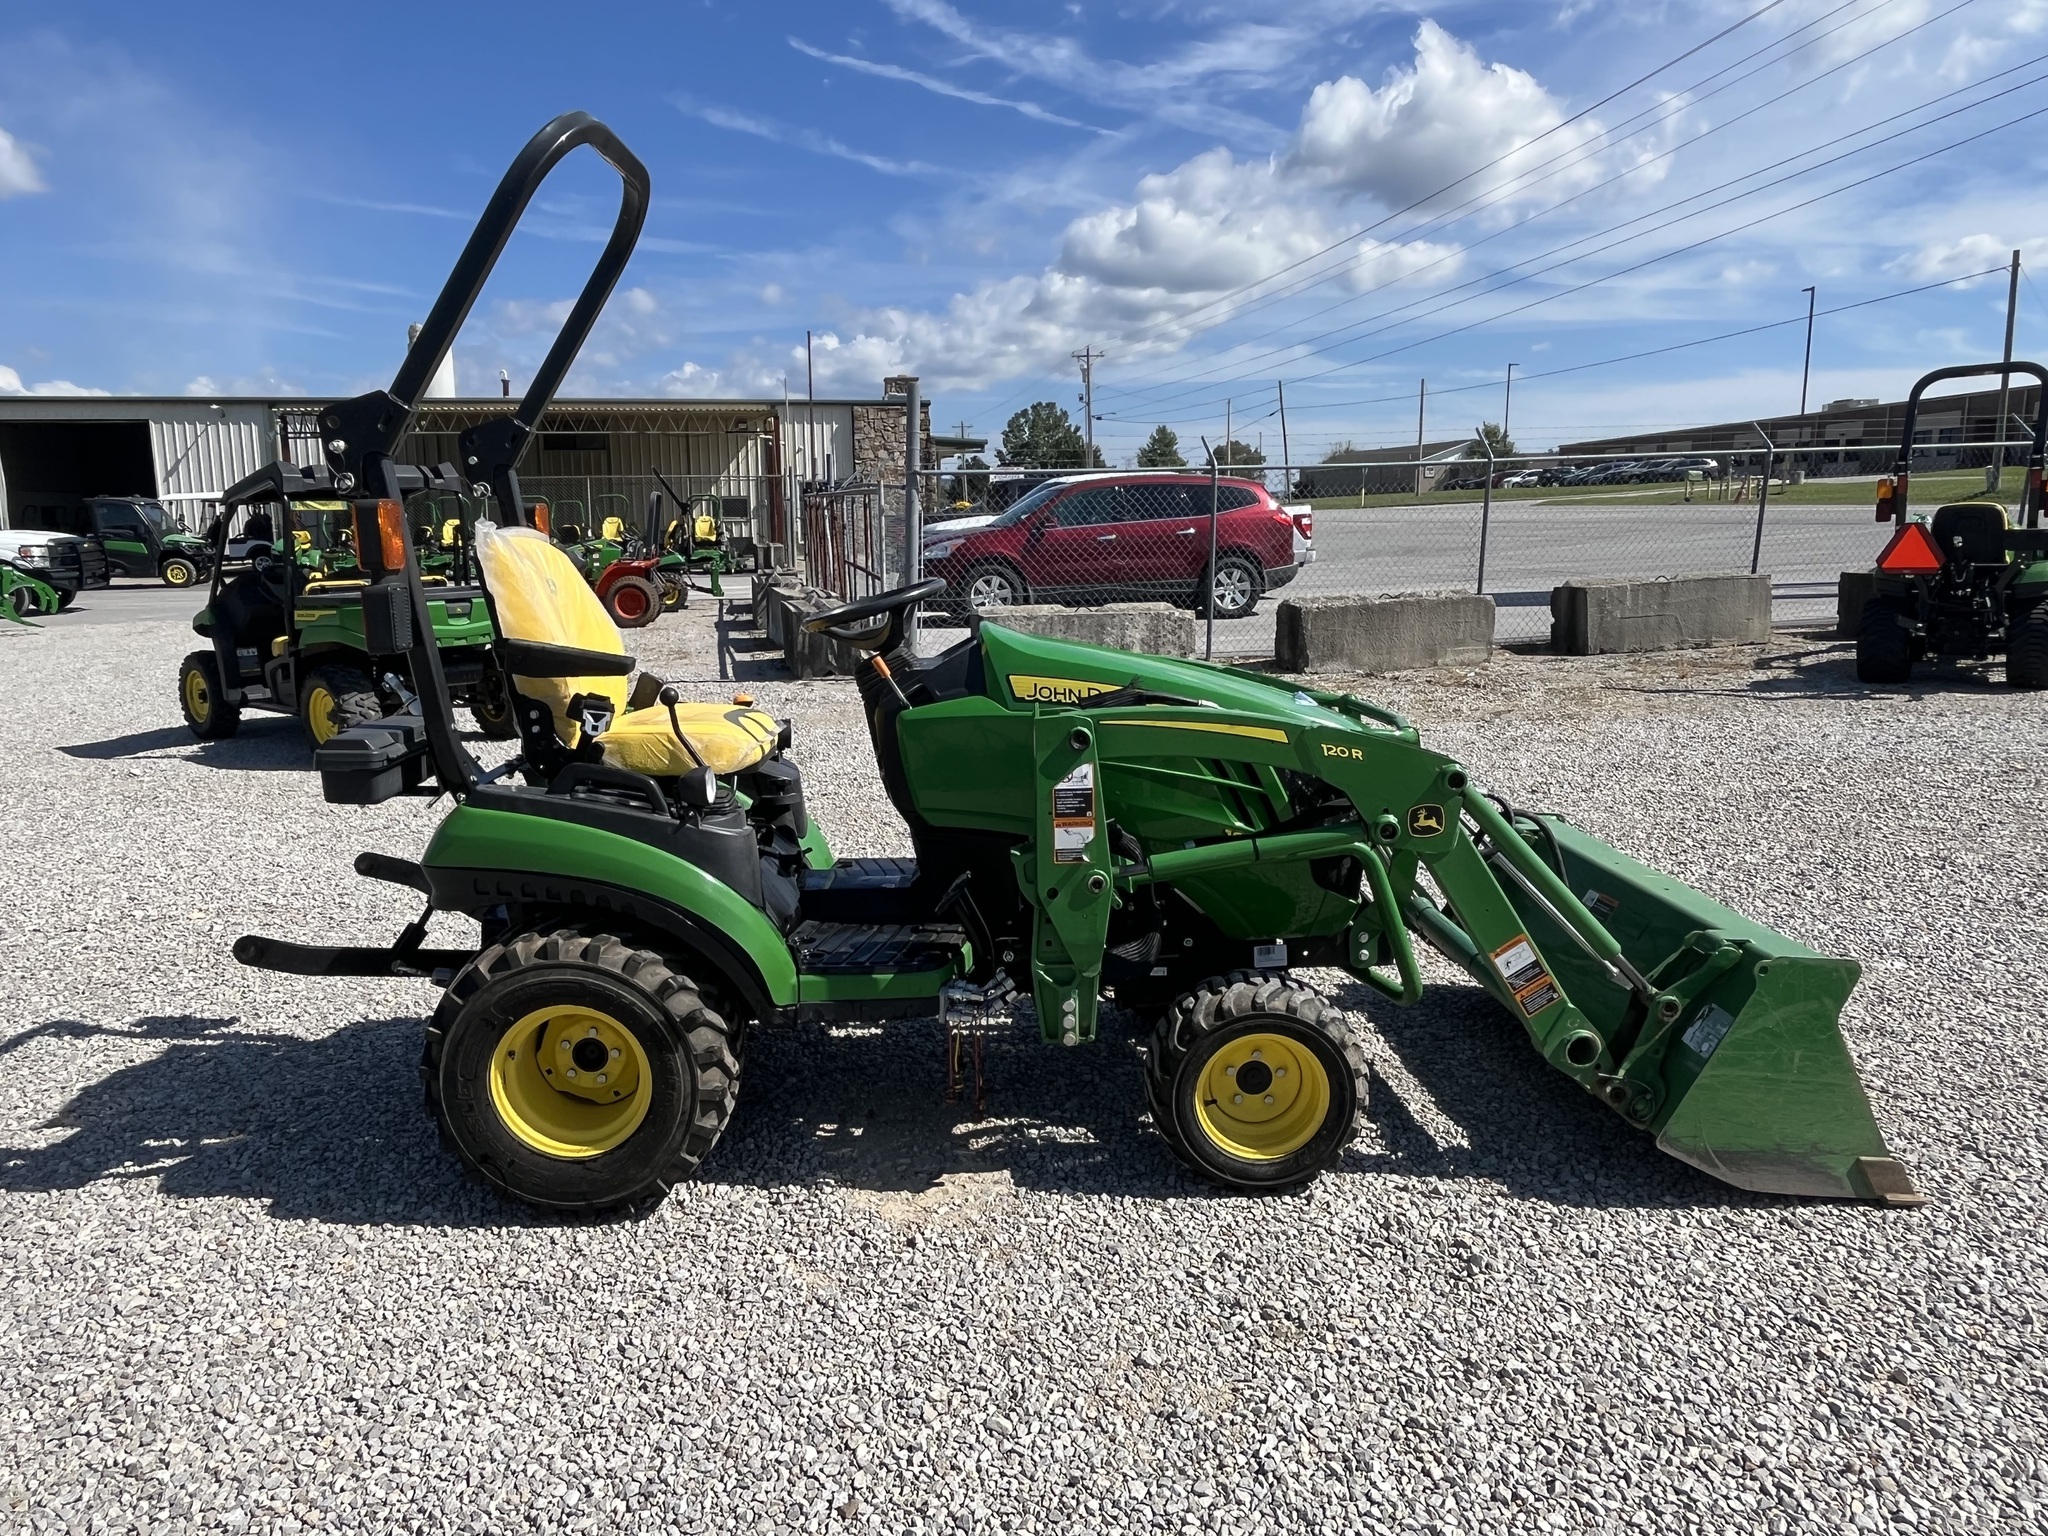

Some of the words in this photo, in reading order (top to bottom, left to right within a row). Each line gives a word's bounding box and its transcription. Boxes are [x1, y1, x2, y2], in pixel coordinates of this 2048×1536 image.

[1026, 683, 1081, 703] JOHN
[1320, 743, 1349, 758] 120
[1351, 748, 1364, 761] R
